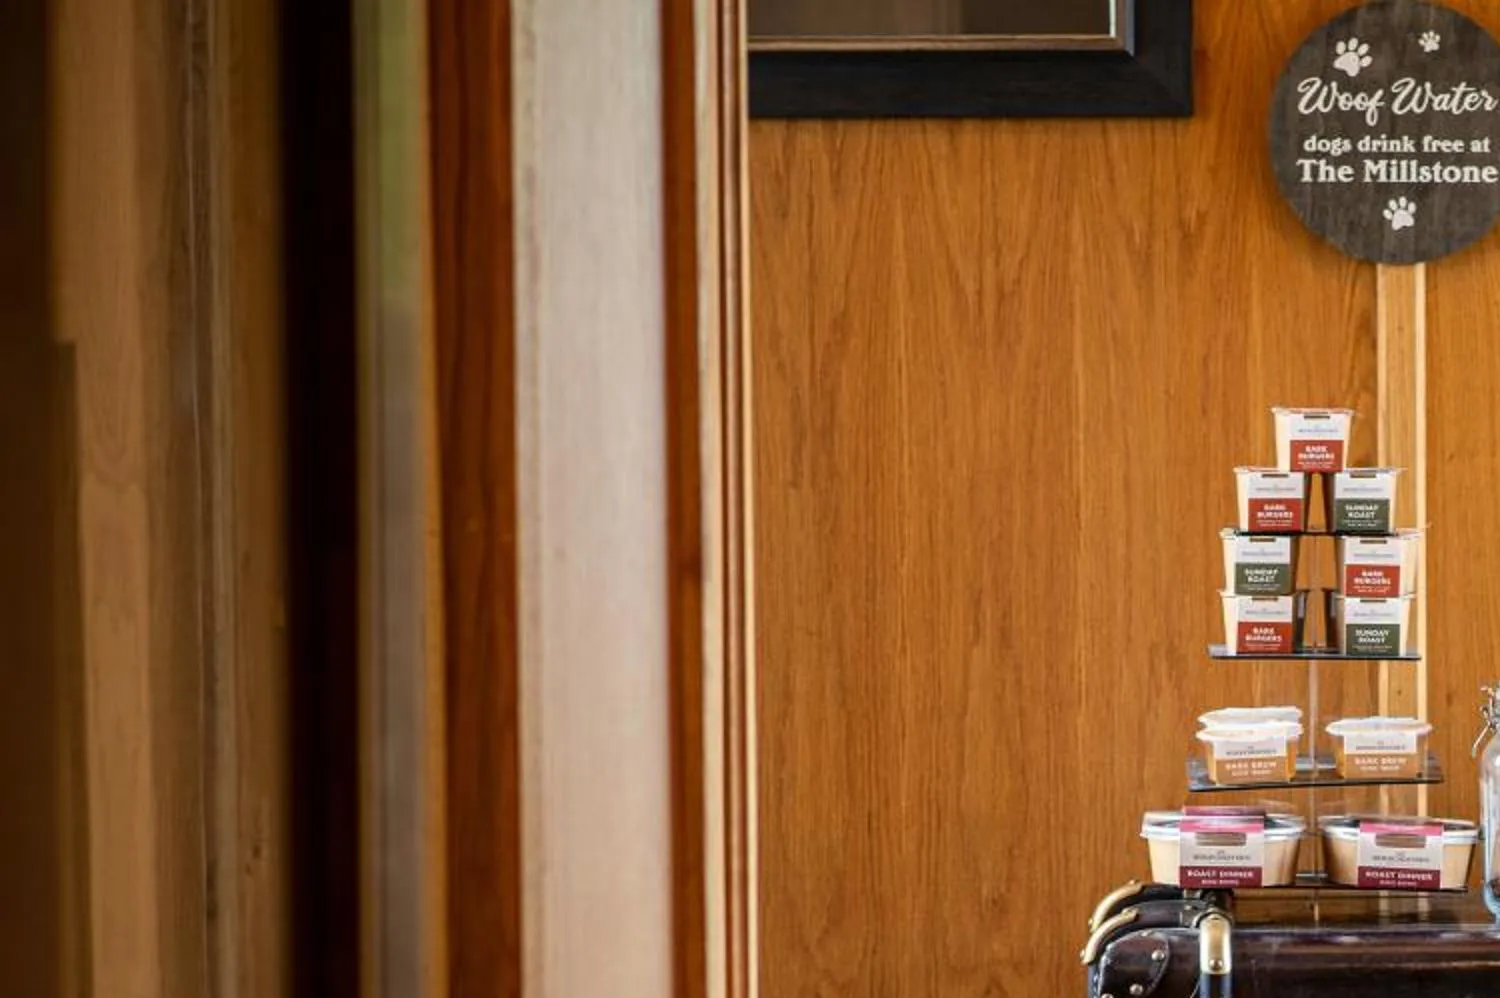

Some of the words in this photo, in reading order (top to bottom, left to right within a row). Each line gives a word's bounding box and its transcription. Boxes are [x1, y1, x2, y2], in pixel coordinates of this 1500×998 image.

[1297, 77, 1384, 127] Woof
[1391, 78, 1499, 115] Water
[1303, 135, 1352, 156] dogs
[1357, 134, 1416, 153] drink
[1423, 134, 1465, 153] free
[1470, 136, 1491, 153] at
[1296, 159, 1354, 183] The
[1363, 159, 1499, 183] Millstone
[1187, 869, 1217, 877] ROAST
